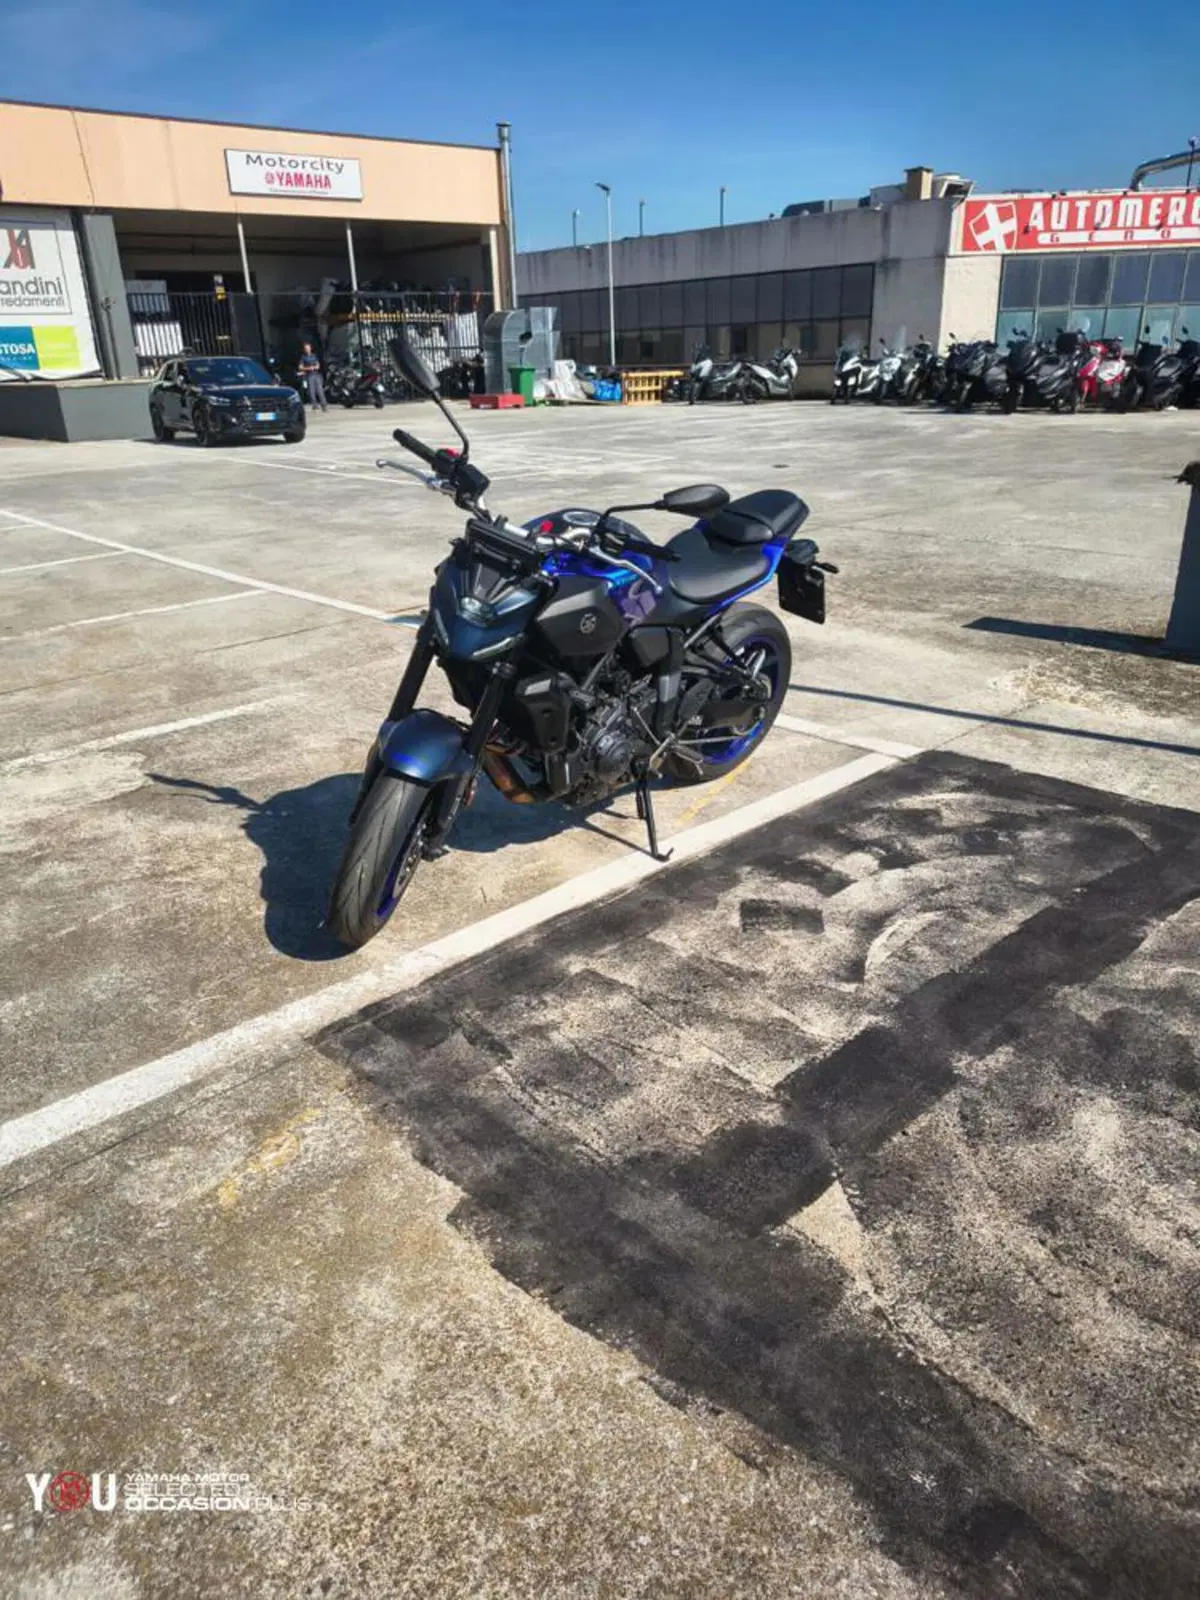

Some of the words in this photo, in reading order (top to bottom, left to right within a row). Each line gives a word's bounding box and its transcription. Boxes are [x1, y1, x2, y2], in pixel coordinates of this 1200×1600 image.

[245, 153, 345, 175] Motorcity
[275, 172, 332, 189] YAMAHA
[0, 343, 36, 355] TOSA
